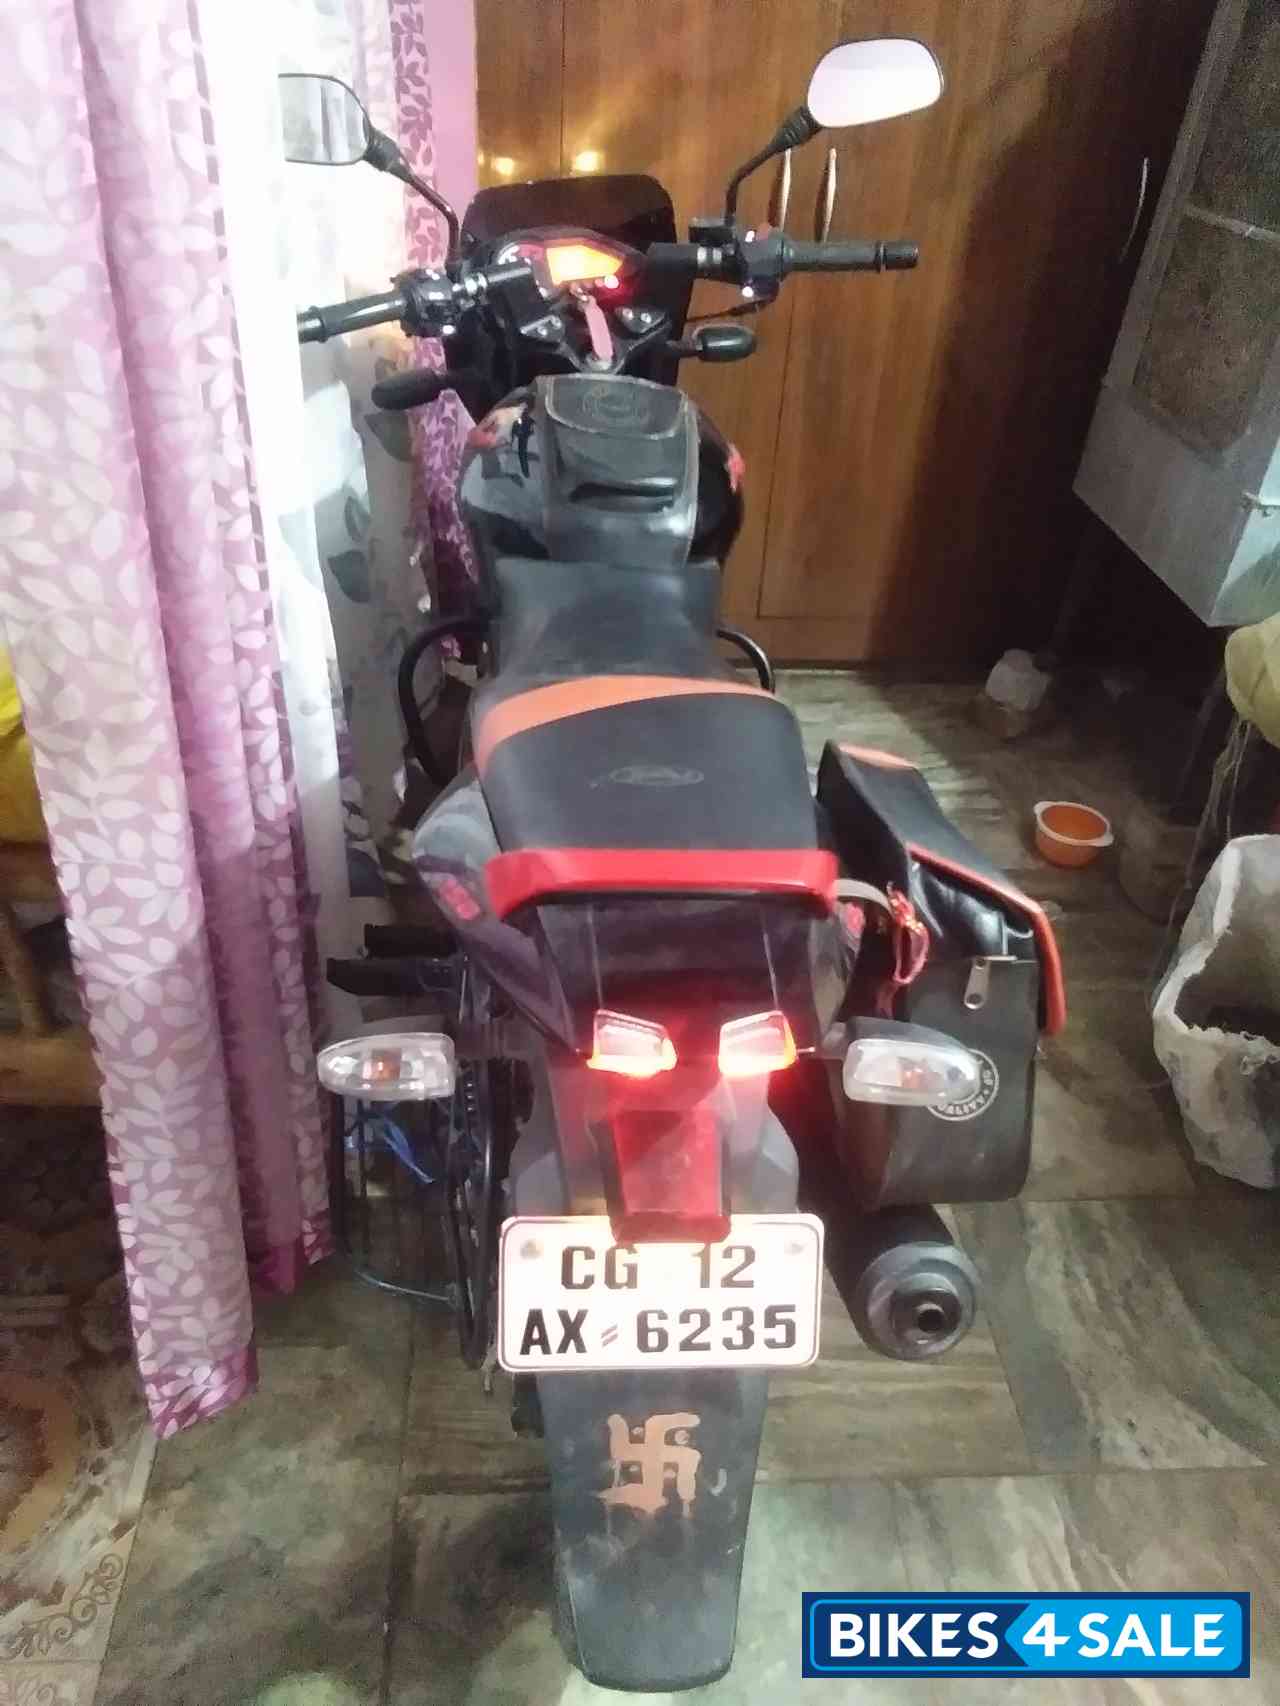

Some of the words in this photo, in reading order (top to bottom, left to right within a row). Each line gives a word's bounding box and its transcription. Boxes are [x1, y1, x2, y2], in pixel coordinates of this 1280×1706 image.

[561, 1243, 638, 1290] CG
[691, 1242, 756, 1289] 12
[519, 1308, 589, 1356] AX
[636, 1304, 796, 1353] 6235
